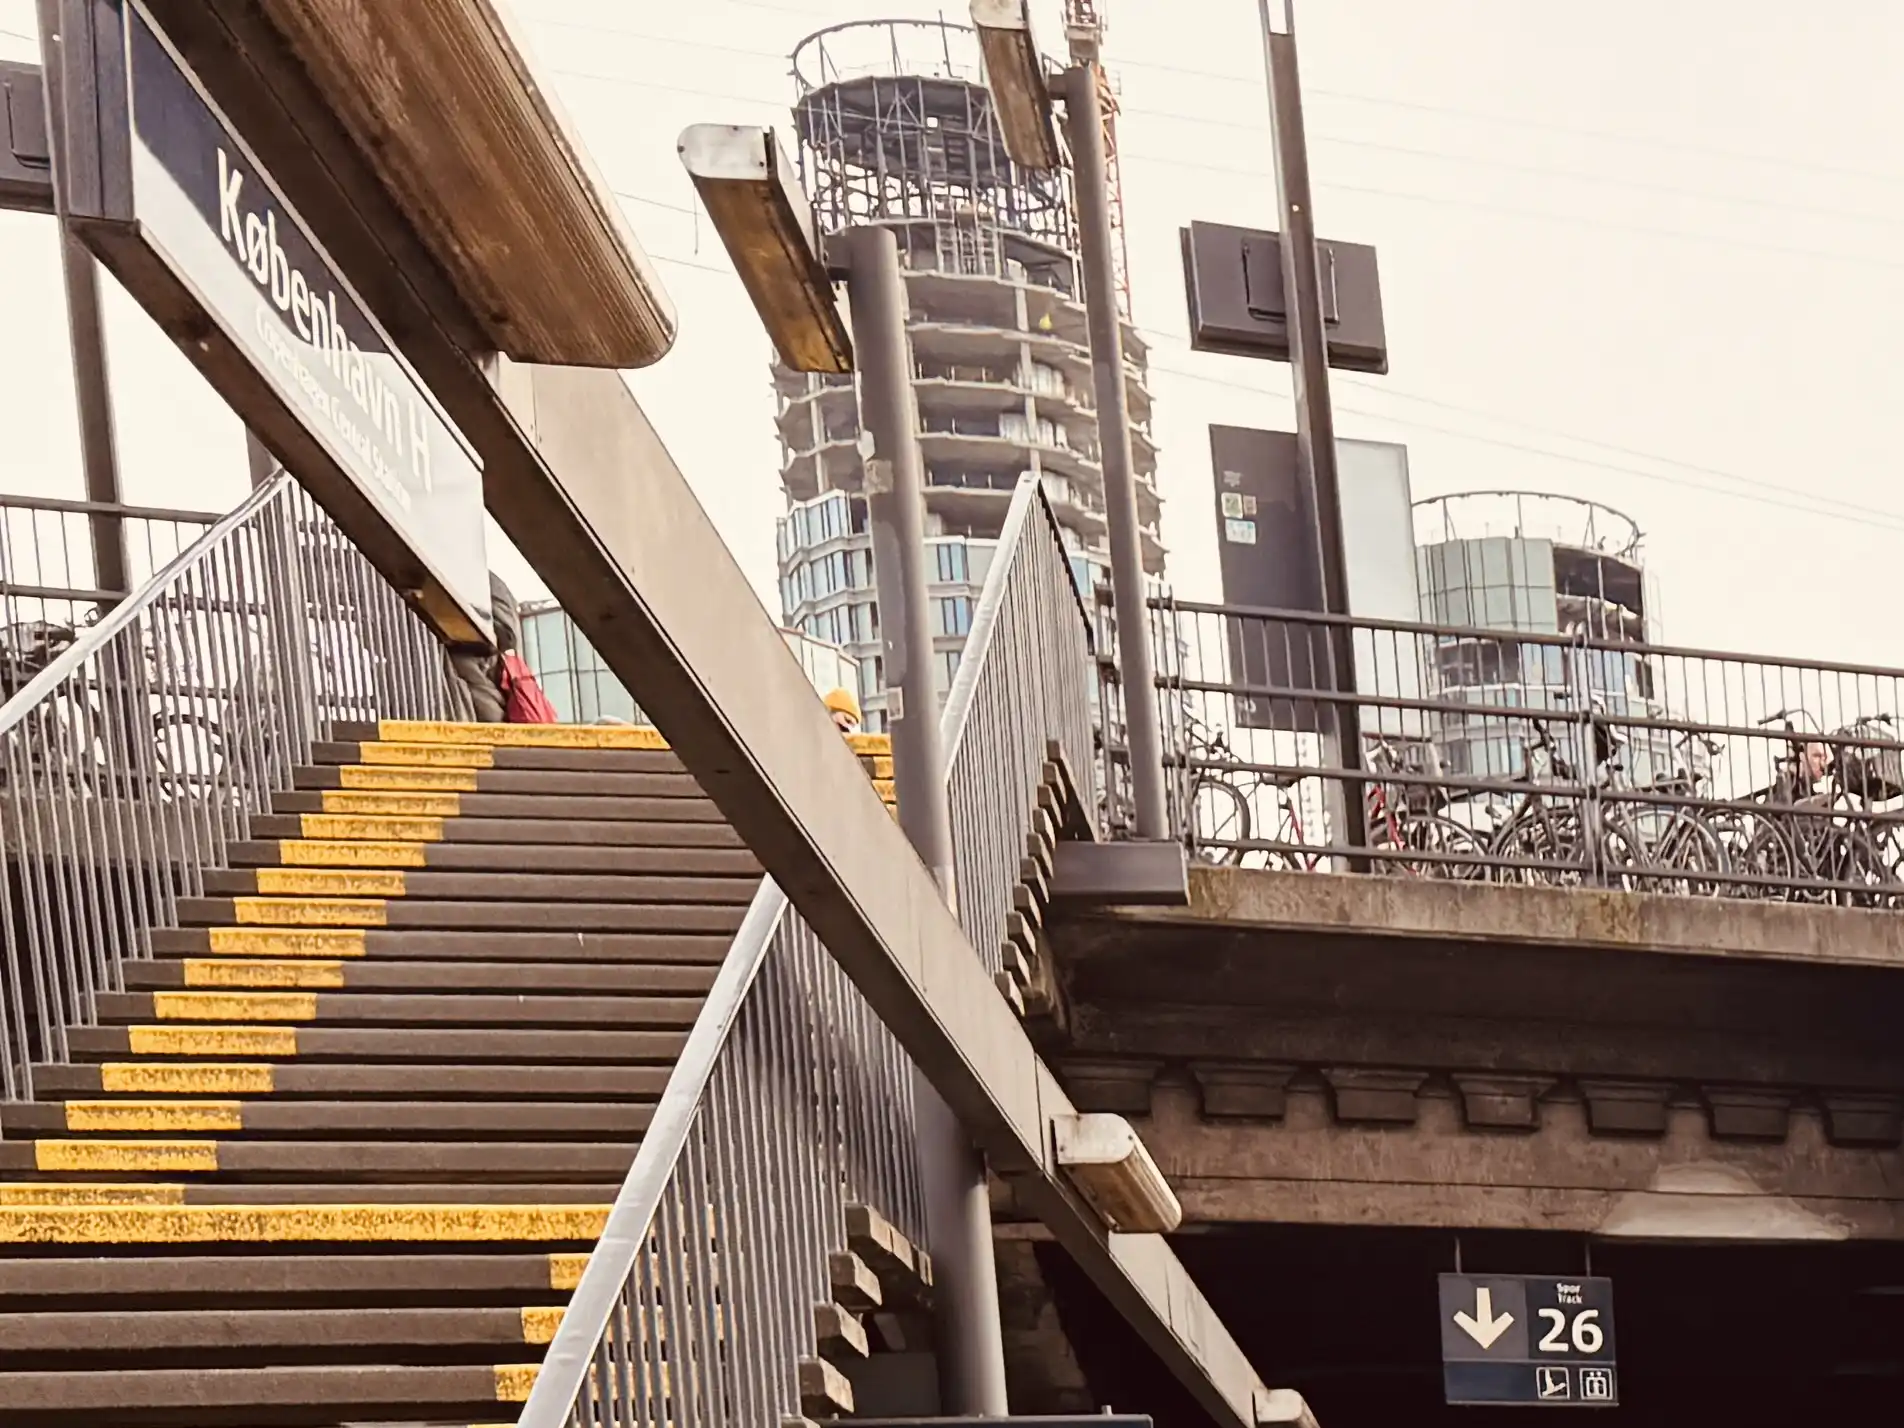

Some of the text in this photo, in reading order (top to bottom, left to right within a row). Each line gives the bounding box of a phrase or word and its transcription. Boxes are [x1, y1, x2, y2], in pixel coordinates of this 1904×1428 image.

[217, 146, 433, 496] København H
[1538, 1308, 1604, 1353] 26
